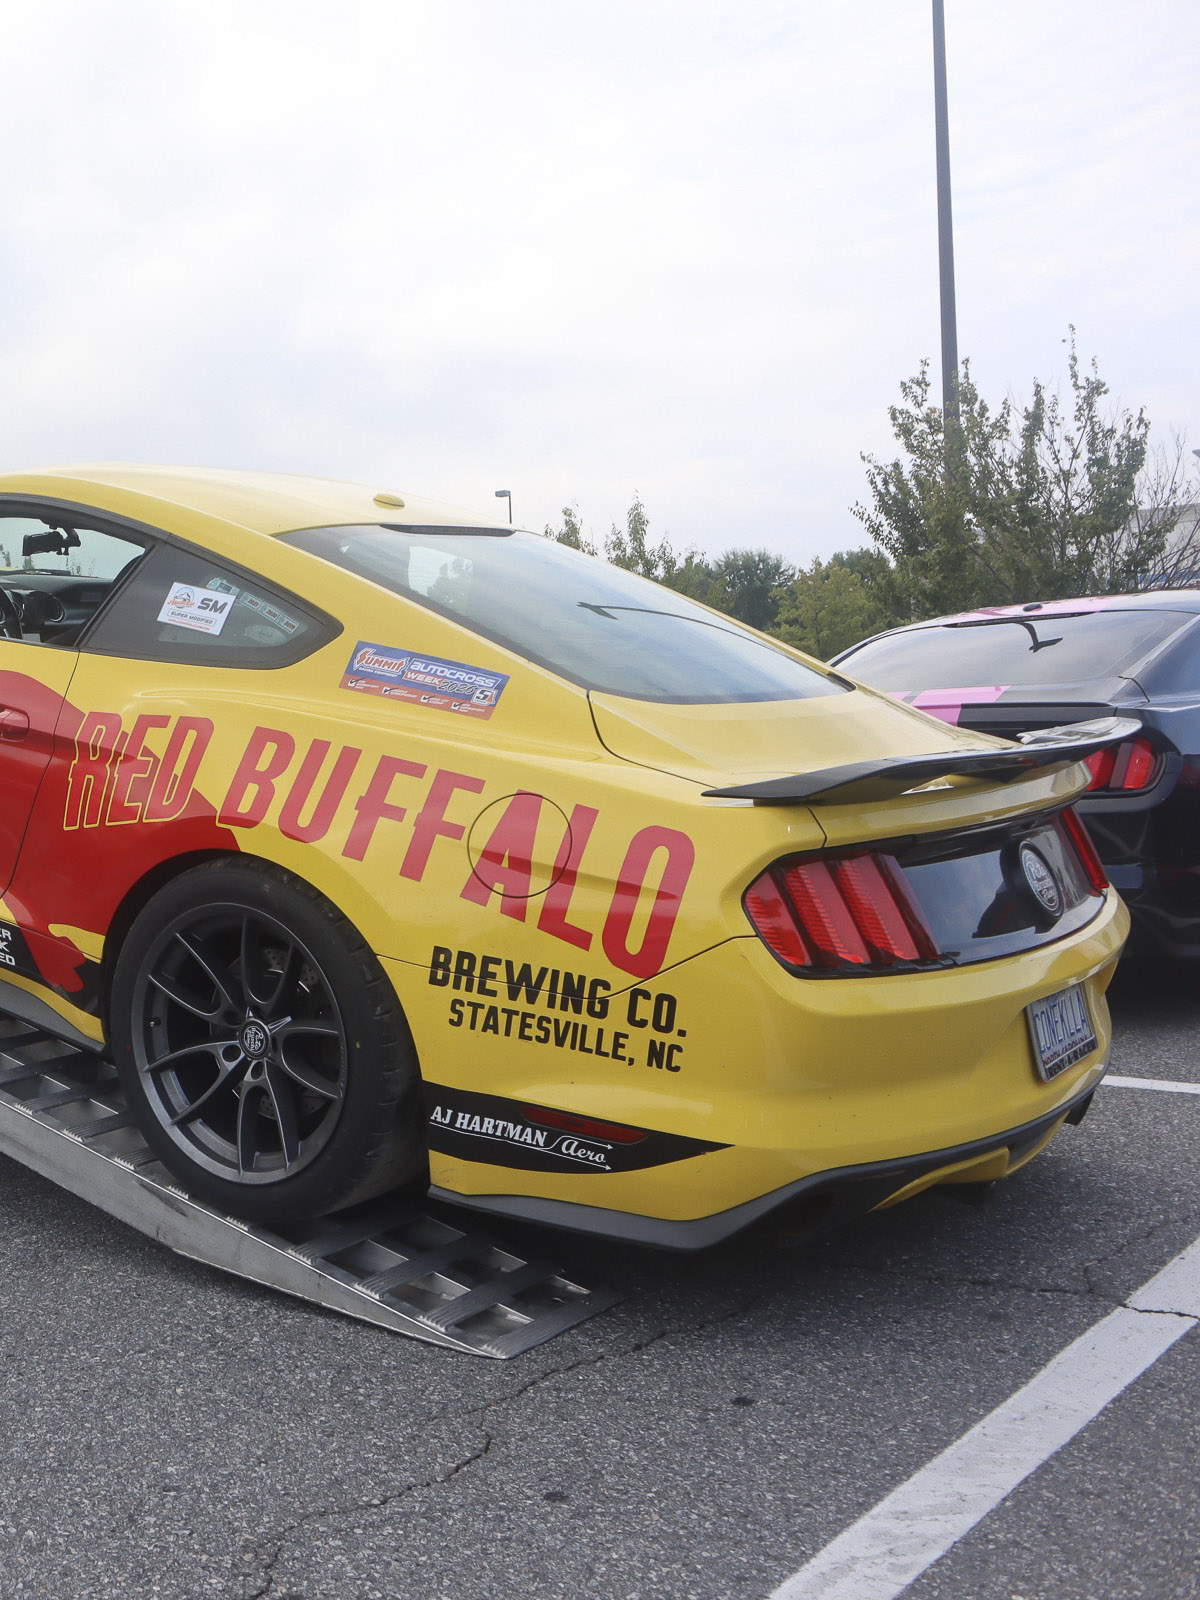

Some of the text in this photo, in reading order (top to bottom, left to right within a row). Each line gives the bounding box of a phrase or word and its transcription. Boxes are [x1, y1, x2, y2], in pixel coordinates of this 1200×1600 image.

[170, 611, 188, 619] SUPER
[189, 614, 214, 625] MODIFIED
[197, 597, 228, 614] SM
[407, 671, 443, 685] WEEK
[410, 661, 497, 687] AUTOCROSS
[63, 710, 696, 979] RED BUFFALO
[428, 945, 688, 1038] BREWING CO.
[448, 998, 684, 1073] STATESVILLE, NC
[430, 1105, 607, 1164] AJ HARTMAN Aero
